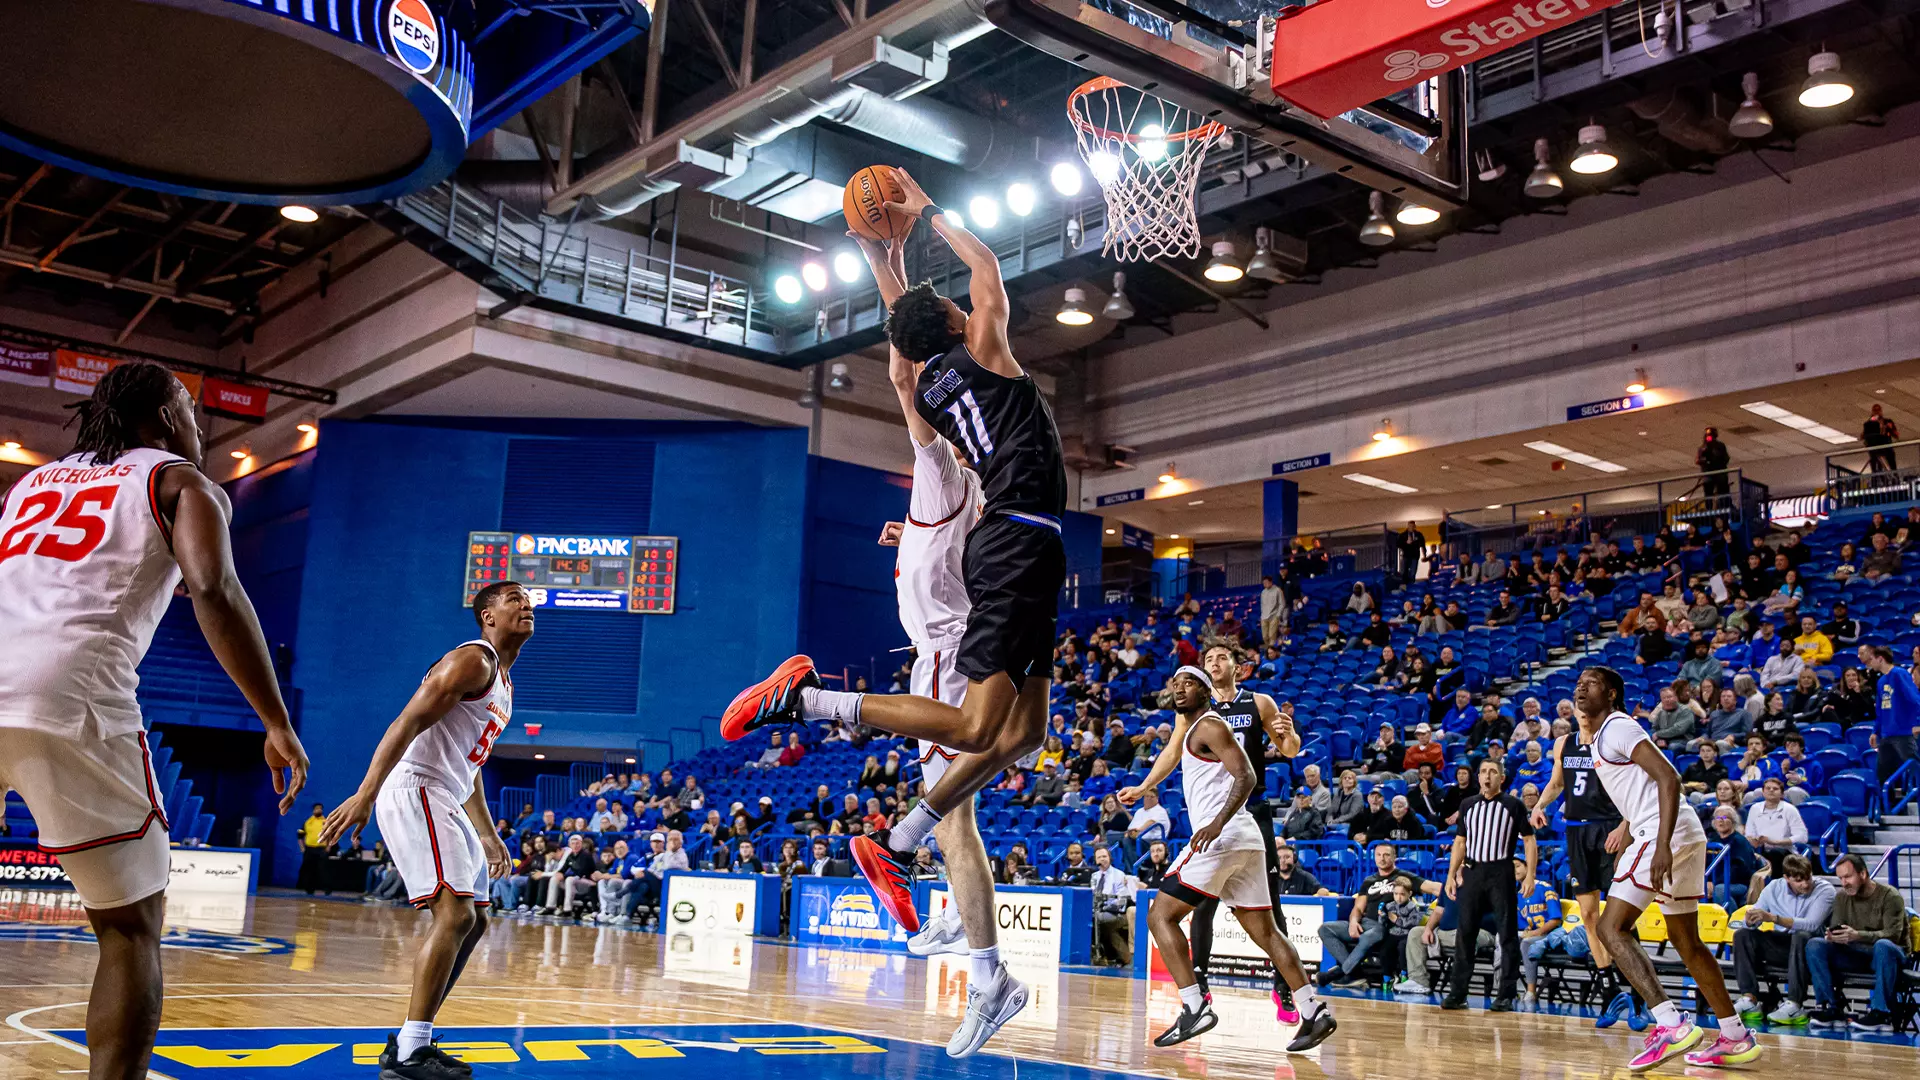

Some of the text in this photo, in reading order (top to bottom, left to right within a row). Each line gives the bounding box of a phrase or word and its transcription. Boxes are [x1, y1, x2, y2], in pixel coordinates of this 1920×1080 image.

[393, 13, 435, 54] PEPSI
[59, 365, 104, 382] HOUST
[923, 368, 963, 408] TAYLOR
[220, 390, 252, 406] WKU
[1581, 397, 1631, 416] SECTION 8
[945, 388, 994, 464] 11
[1282, 459, 1312, 472] SECTION
[30, 463, 137, 488] NICHOLAS
[1103, 493, 1129, 505] SECTION
[0, 484, 120, 564] 25
[1563, 756, 1582, 769] BLUE
[1573, 771, 1588, 796] 5
[1291, 916, 1302, 925] to
[1214, 928, 1247, 942] uilding
[1290, 935, 1319, 945] atters
[1208, 956, 1236, 965] Construction
[1236, 957, 1265, 968] Management
